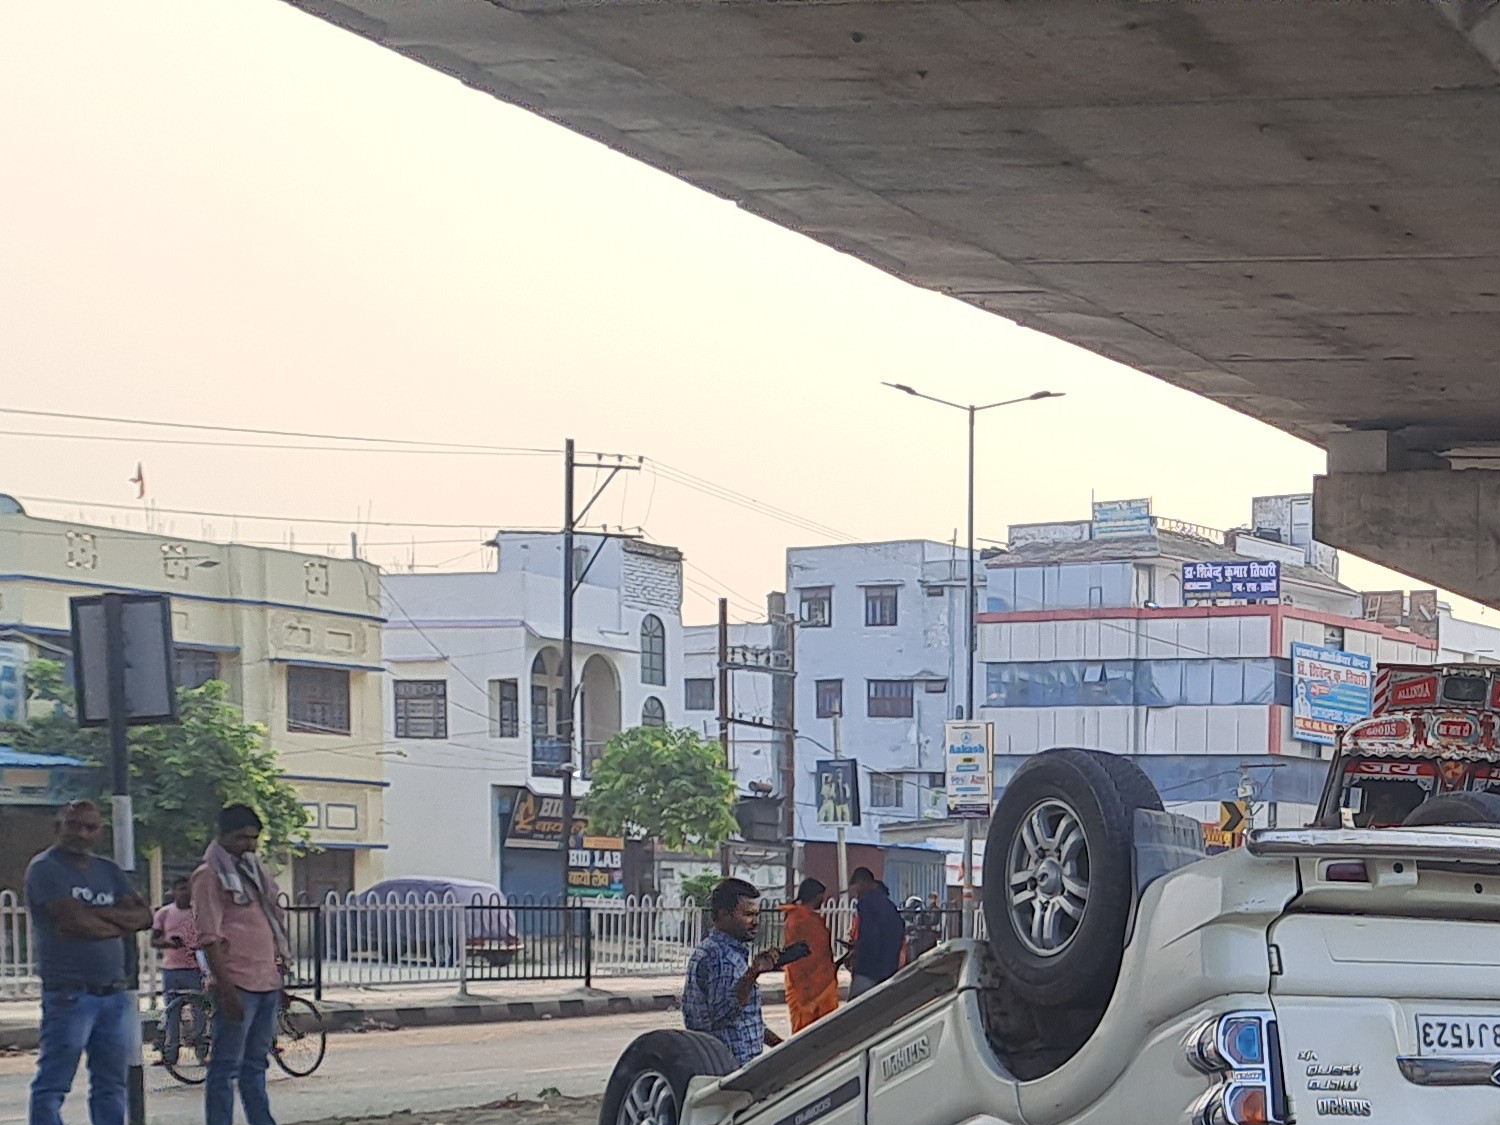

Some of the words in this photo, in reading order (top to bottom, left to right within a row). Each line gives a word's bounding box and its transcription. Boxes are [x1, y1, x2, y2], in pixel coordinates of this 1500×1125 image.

[1366, 723, 1397, 736] GOODS
[949, 743, 985, 754] Aakash
[1359, 762, 1421, 775] जय
[594, 851, 621, 868] LAB
